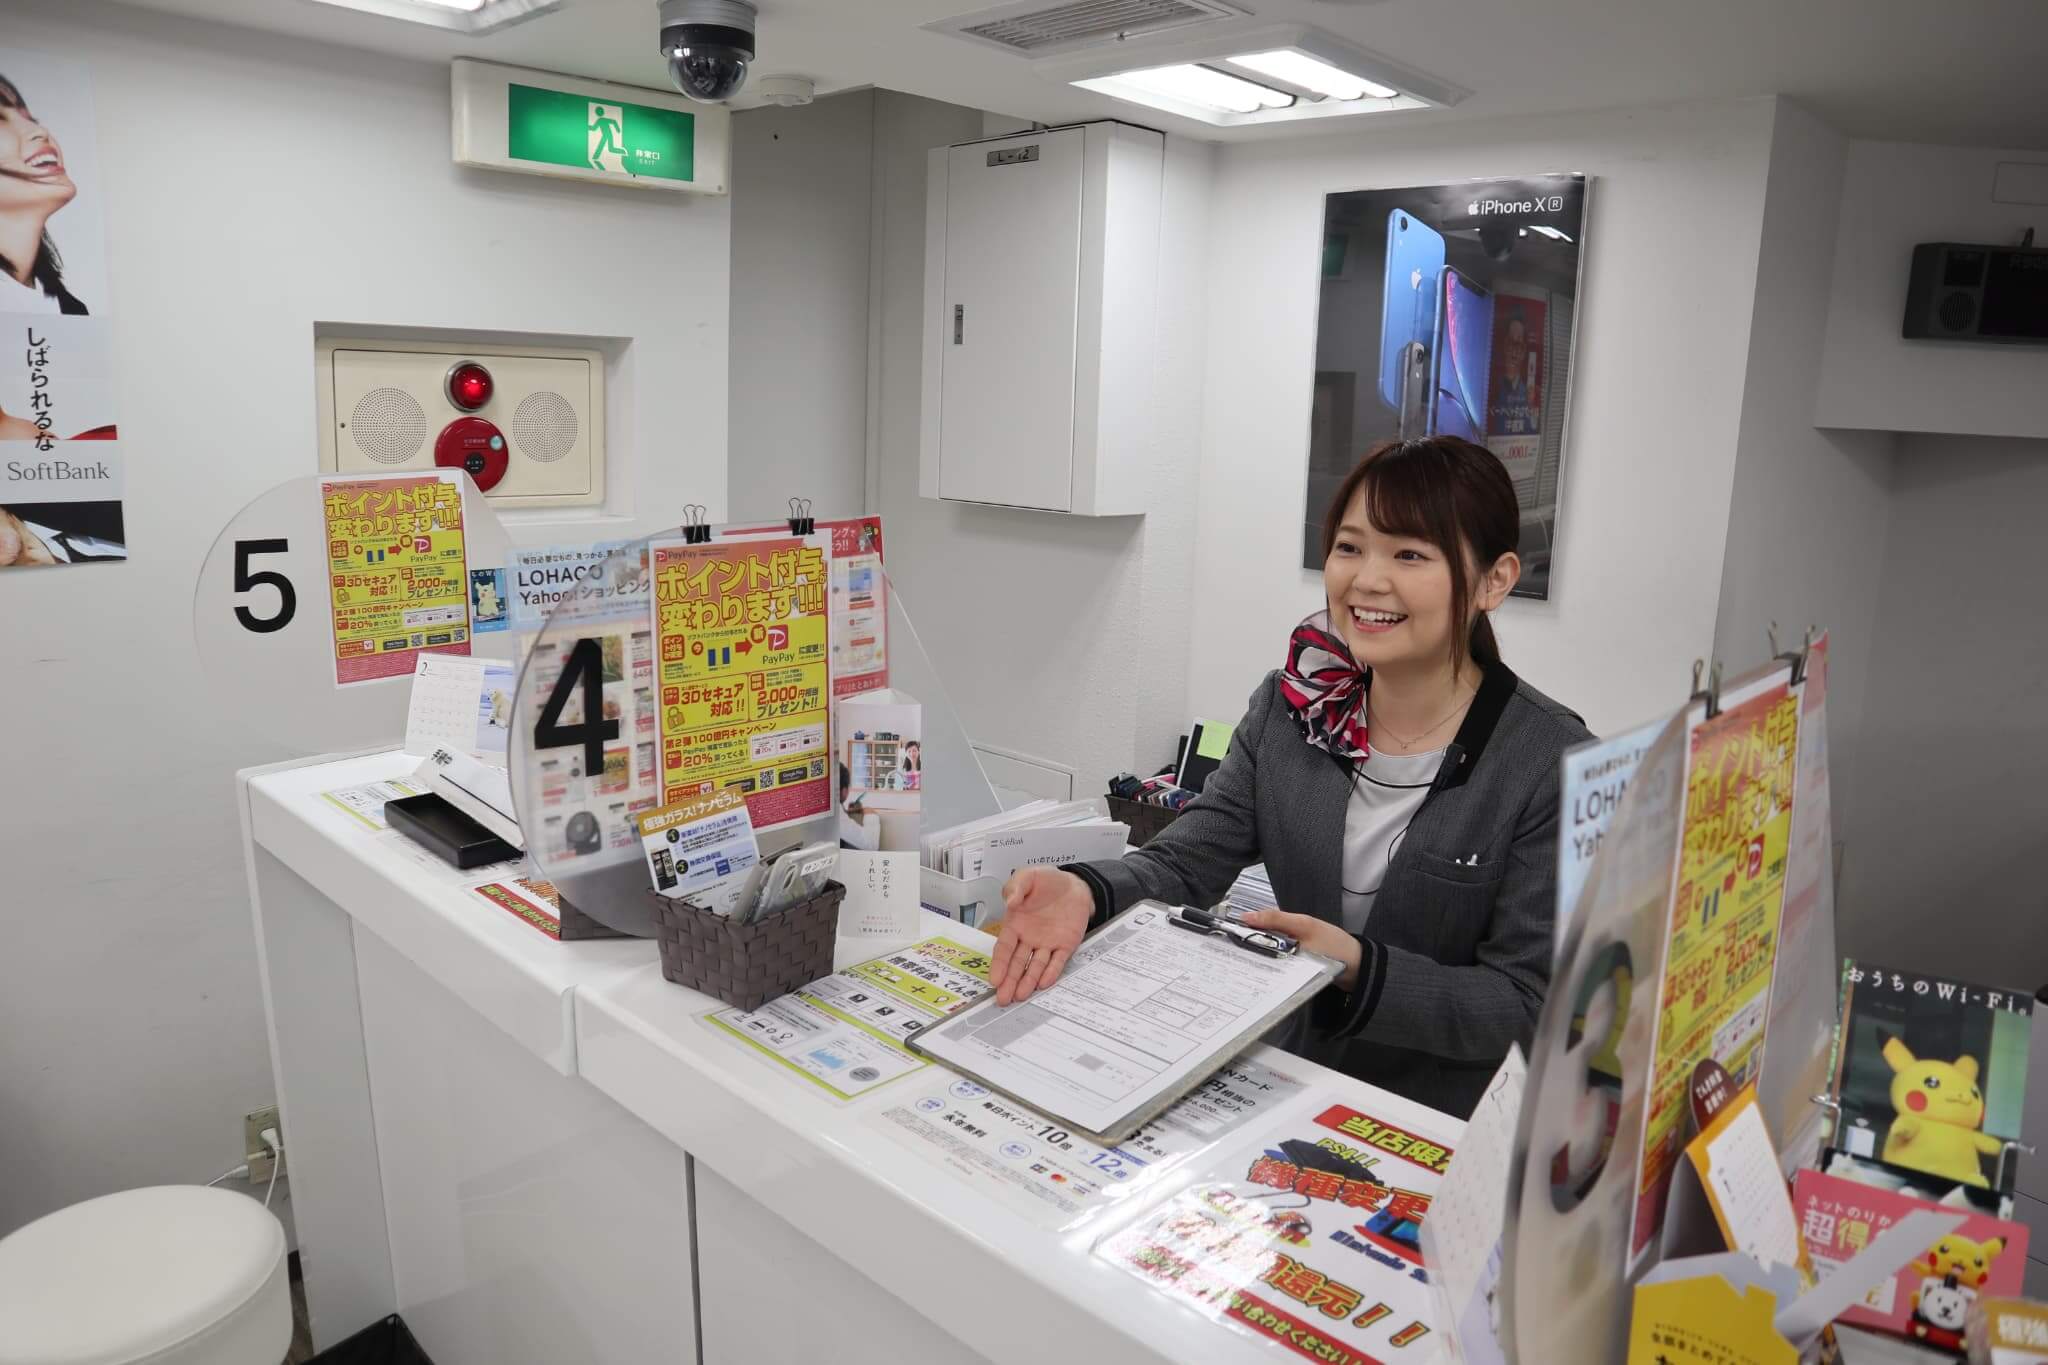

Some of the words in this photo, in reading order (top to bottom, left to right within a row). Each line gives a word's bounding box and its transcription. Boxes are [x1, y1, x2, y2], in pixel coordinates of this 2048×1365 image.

[1481, 200, 1532, 215] iPhone
[26, 327, 54, 451] しばられるな
[7, 461, 110, 481] SoftBank
[668, 550, 697, 560] PayPay
[234, 538, 297, 633] 5
[346, 574, 397, 588] 3Dセキュア
[517, 564, 604, 588] LOHACO
[419, 661, 428, 677] 2
[762, 653, 795, 665] PayPay
[681, 683, 745, 705] 3Dセキュア
[757, 686, 819, 706] 2,000円相当
[534, 637, 619, 778] 4
[710, 699, 745, 718] 対応!!
[757, 697, 819, 719] プレゼント!!
[665, 722, 777, 750] 第2弾100億円キャンペーン
[1848, 966, 2027, 1017] おうちのWi-Fi。
[1316, 1138, 1381, 1169] PS4!!
[1329, 1230, 1407, 1271] Nintendo
